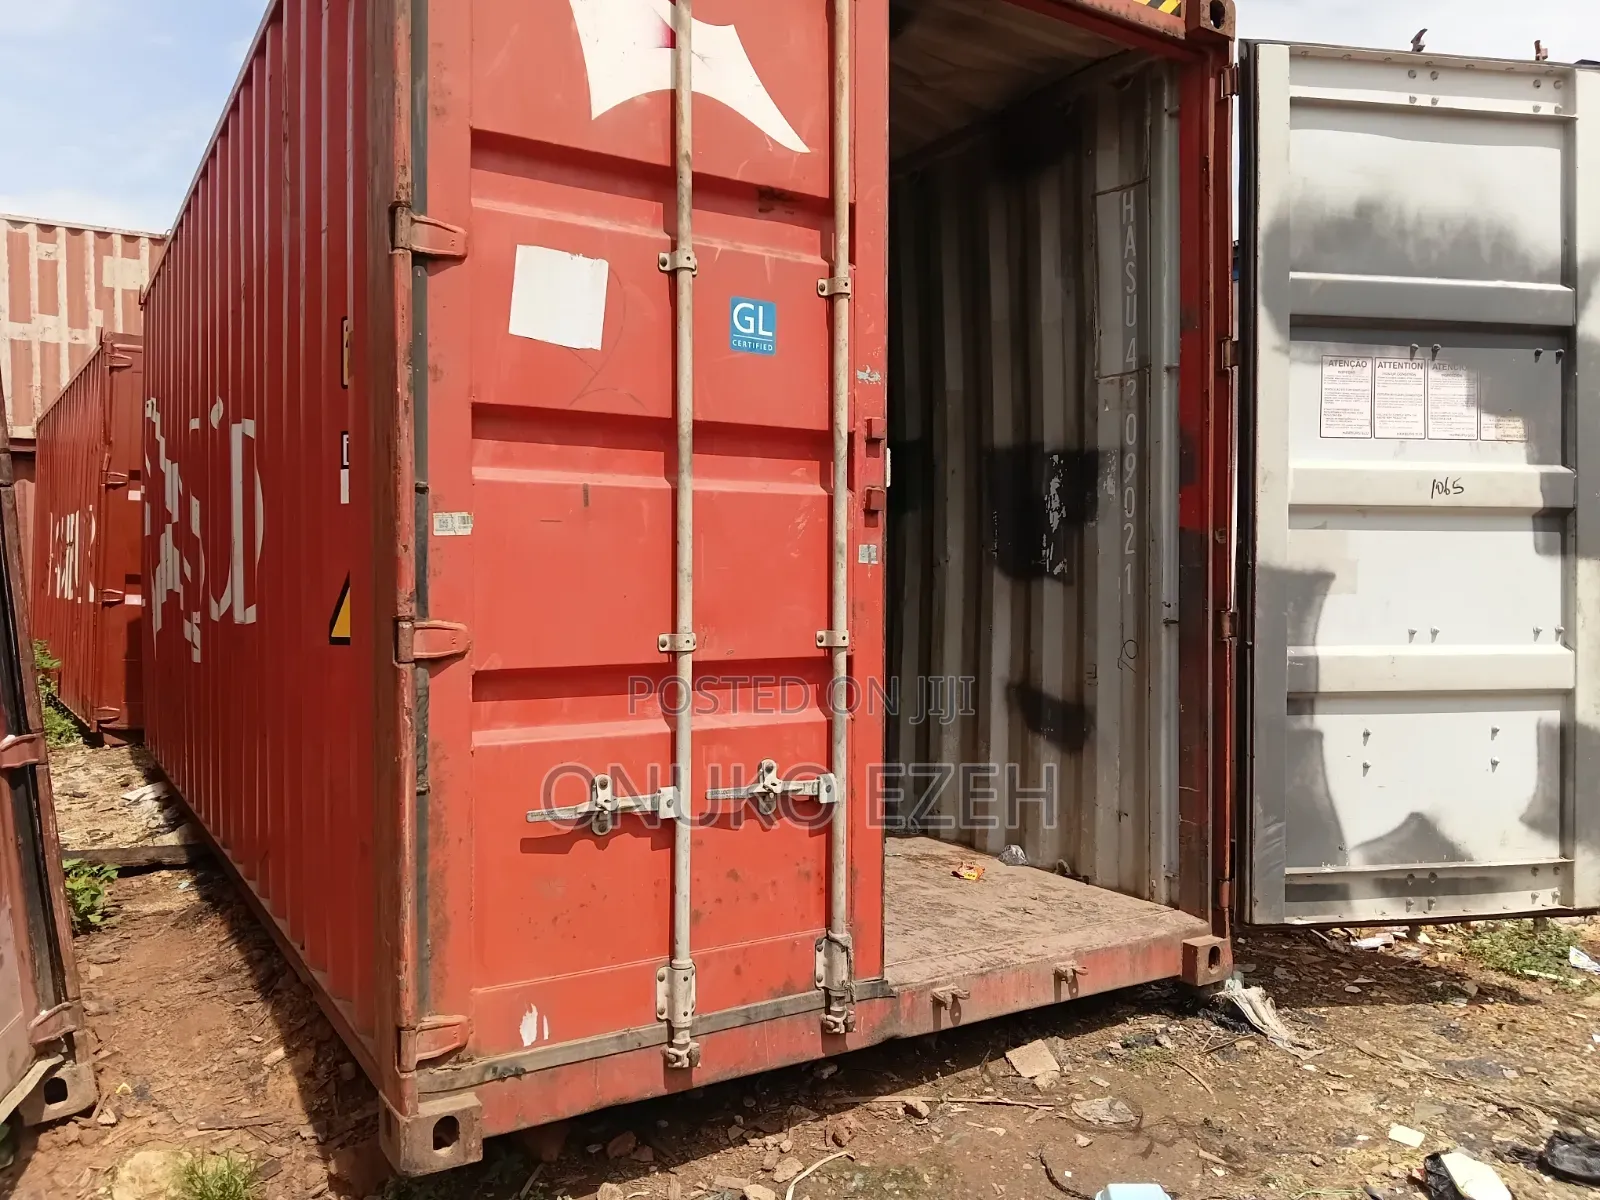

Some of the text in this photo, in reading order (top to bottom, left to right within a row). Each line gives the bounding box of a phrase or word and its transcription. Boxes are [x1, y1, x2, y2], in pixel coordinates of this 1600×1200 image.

[1121, 189, 1138, 328] HASU
[732, 302, 773, 337] GL
[732, 339, 773, 351] CERTIFIED
[1328, 358, 1368, 369] ATENÇÃO
[1377, 361, 1424, 370] ATTENTION
[1430, 477, 1465, 499] 1065
